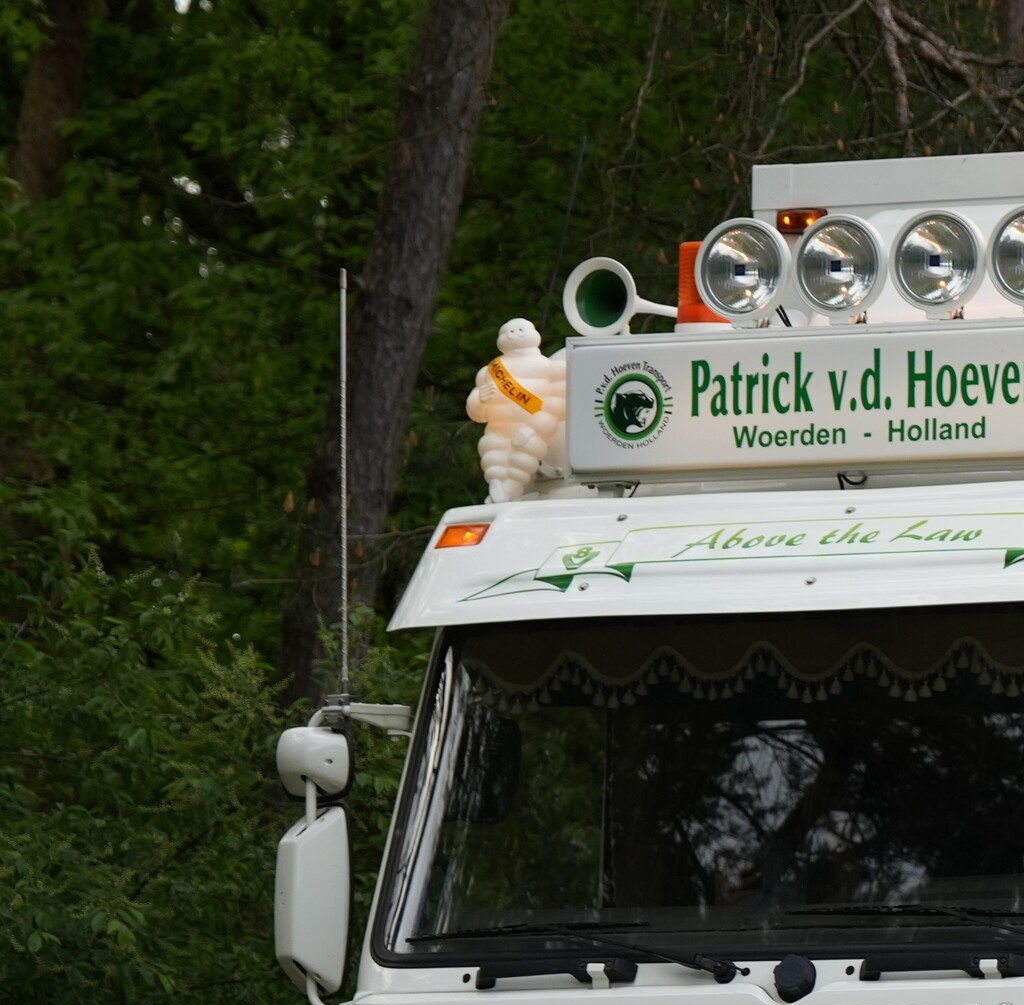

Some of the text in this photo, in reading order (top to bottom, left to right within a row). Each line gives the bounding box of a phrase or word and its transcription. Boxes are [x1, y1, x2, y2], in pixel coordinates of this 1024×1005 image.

[610, 361, 642, 377] Hoeven
[642, 360, 673, 393] Transport
[690, 351, 814, 418] Patrick
[828, 347, 892, 412] v.d.
[598, 415, 670, 450] WOERDEN HOLLAND
[732, 422, 847, 449] Woerden
[887, 416, 987, 442] Holland
[670, 518, 983, 559] Above the Law
